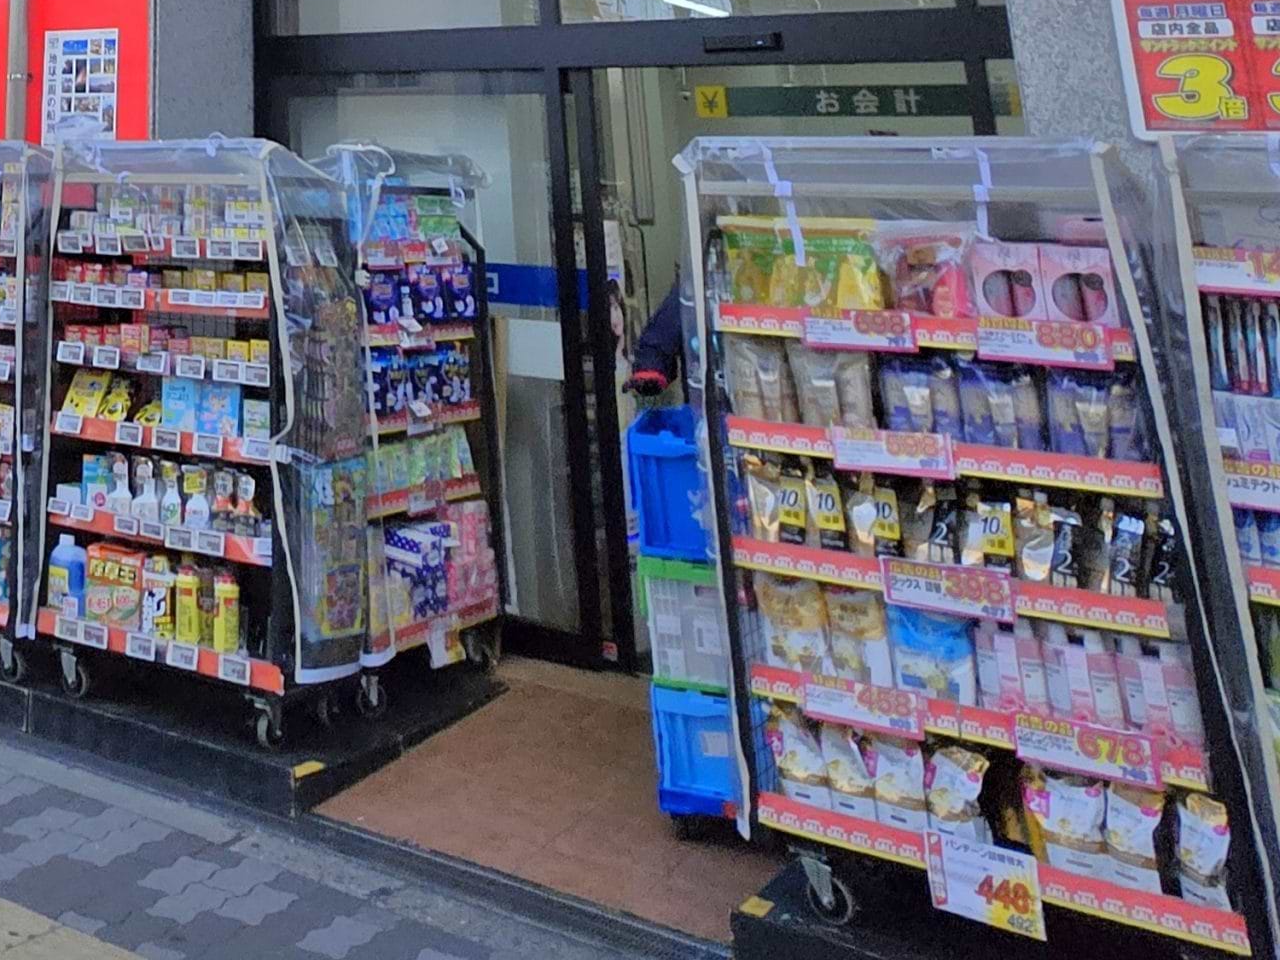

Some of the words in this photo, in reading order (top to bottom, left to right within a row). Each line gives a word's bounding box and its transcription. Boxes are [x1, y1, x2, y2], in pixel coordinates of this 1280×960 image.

[816, 88, 920, 114] お会計
[975, 874, 1031, 915] 448
